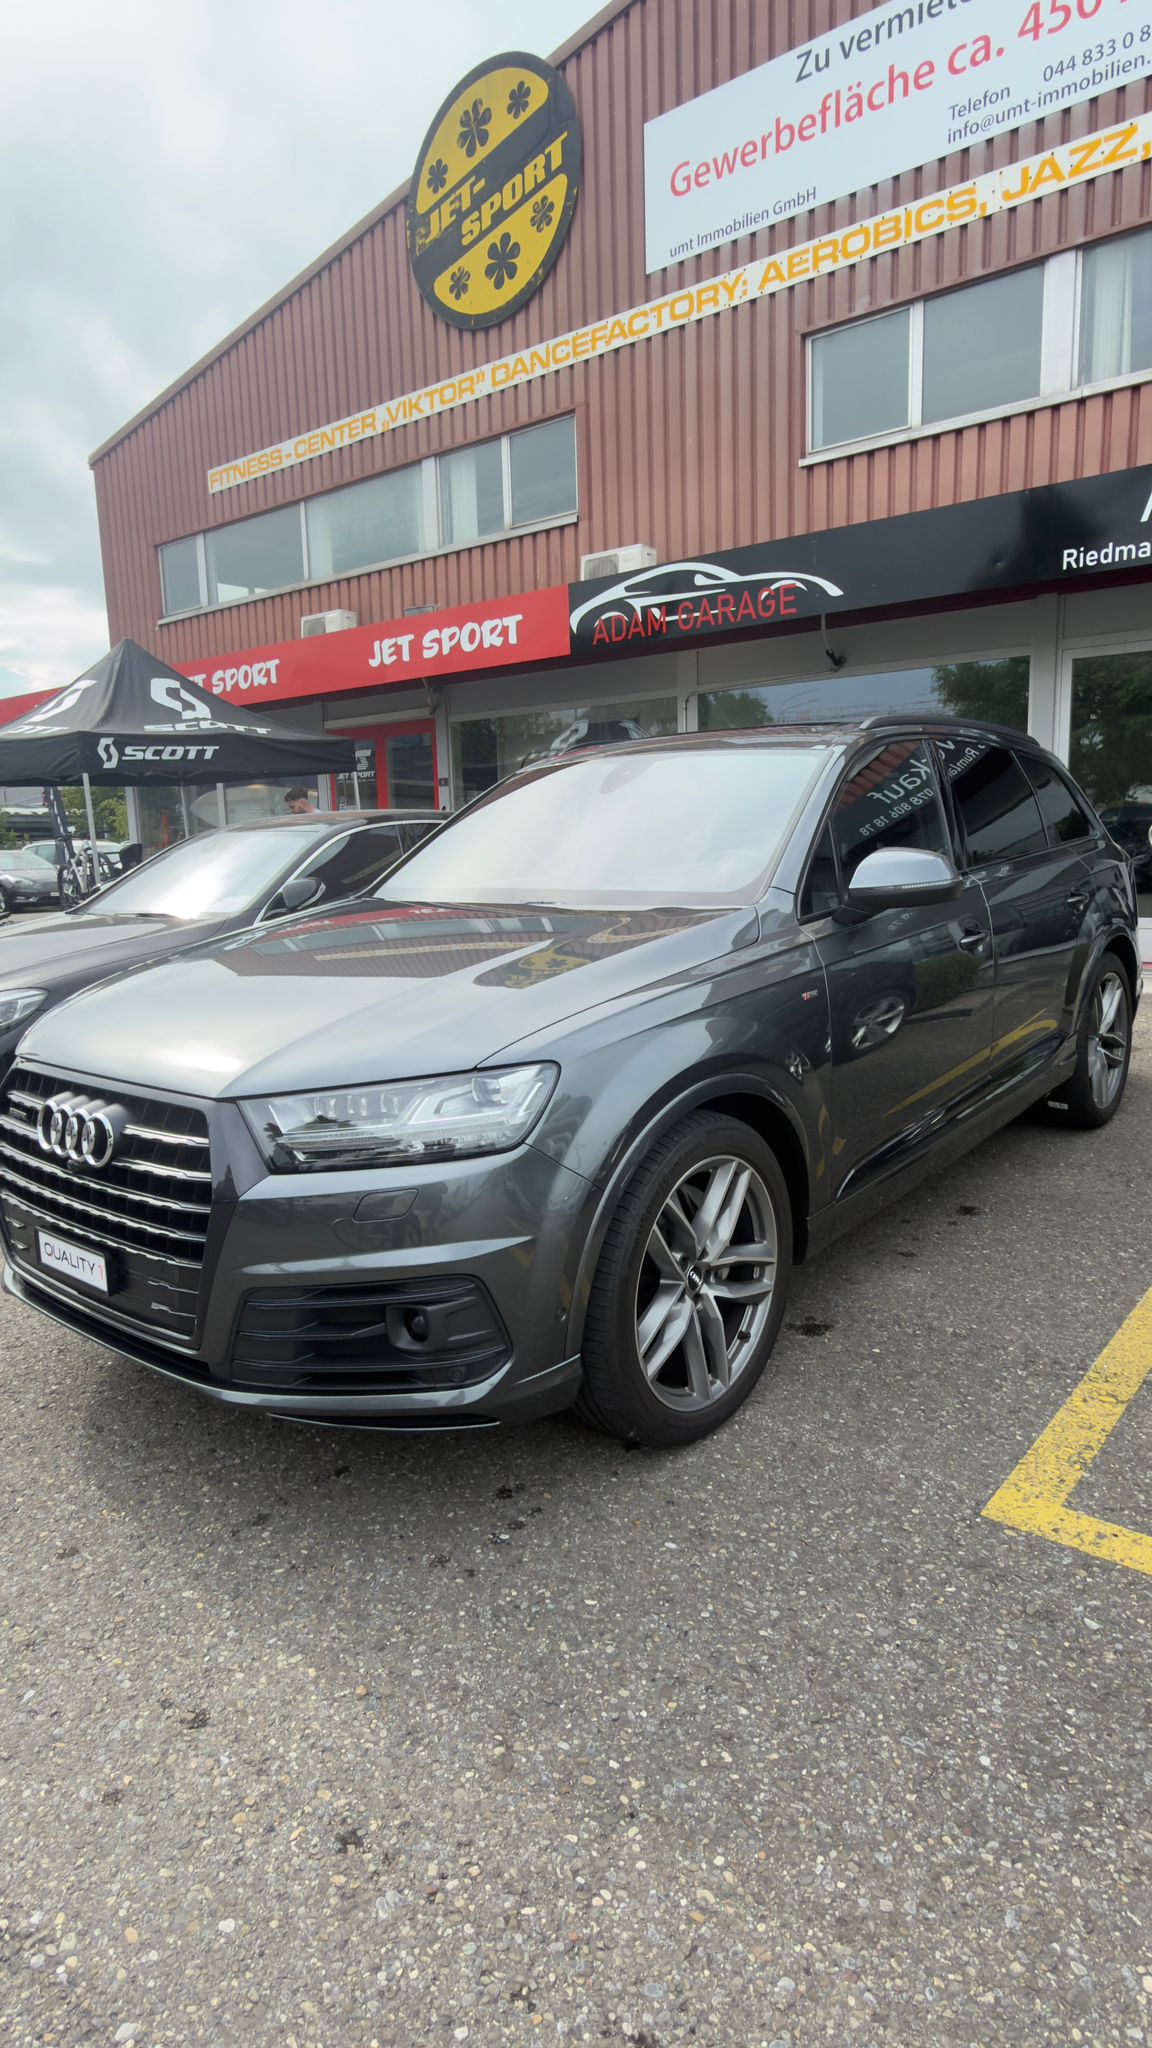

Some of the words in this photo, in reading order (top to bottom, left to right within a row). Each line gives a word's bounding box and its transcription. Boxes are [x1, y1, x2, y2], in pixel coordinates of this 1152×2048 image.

[795, 48, 831, 83] Zu
[839, 0, 971, 60] vermie
[949, 84, 1011, 121] Telefon
[1043, 54, 1077, 82] 044
[1082, 38, 1116, 66] 833
[1122, 31, 1134, 49] 0
[669, 60, 936, 197] Gewerbefläche
[948, 33, 1006, 75] ca.
[947, 54, 1152, 145] info@umt-immobilien.
[461, 130, 569, 247] SPORT
[669, 238, 695, 258] umt
[697, 207, 770, 248] Immobilien
[772, 186, 817, 216] GmbH
[491, 271, 749, 389] DANCEFACTORY:
[757, 185, 989, 292] AEROBICS,
[1062, 541, 1152, 571] Riedma
[368, 633, 415, 668] JET
[422, 613, 524, 660] SPORT
[592, 606, 667, 646] ADAM
[677, 583, 798, 632] GARAGE
[211, 658, 281, 695] SPORT
[121, 745, 220, 761] SCOTT
[143, 720, 272, 734] SCOTT
